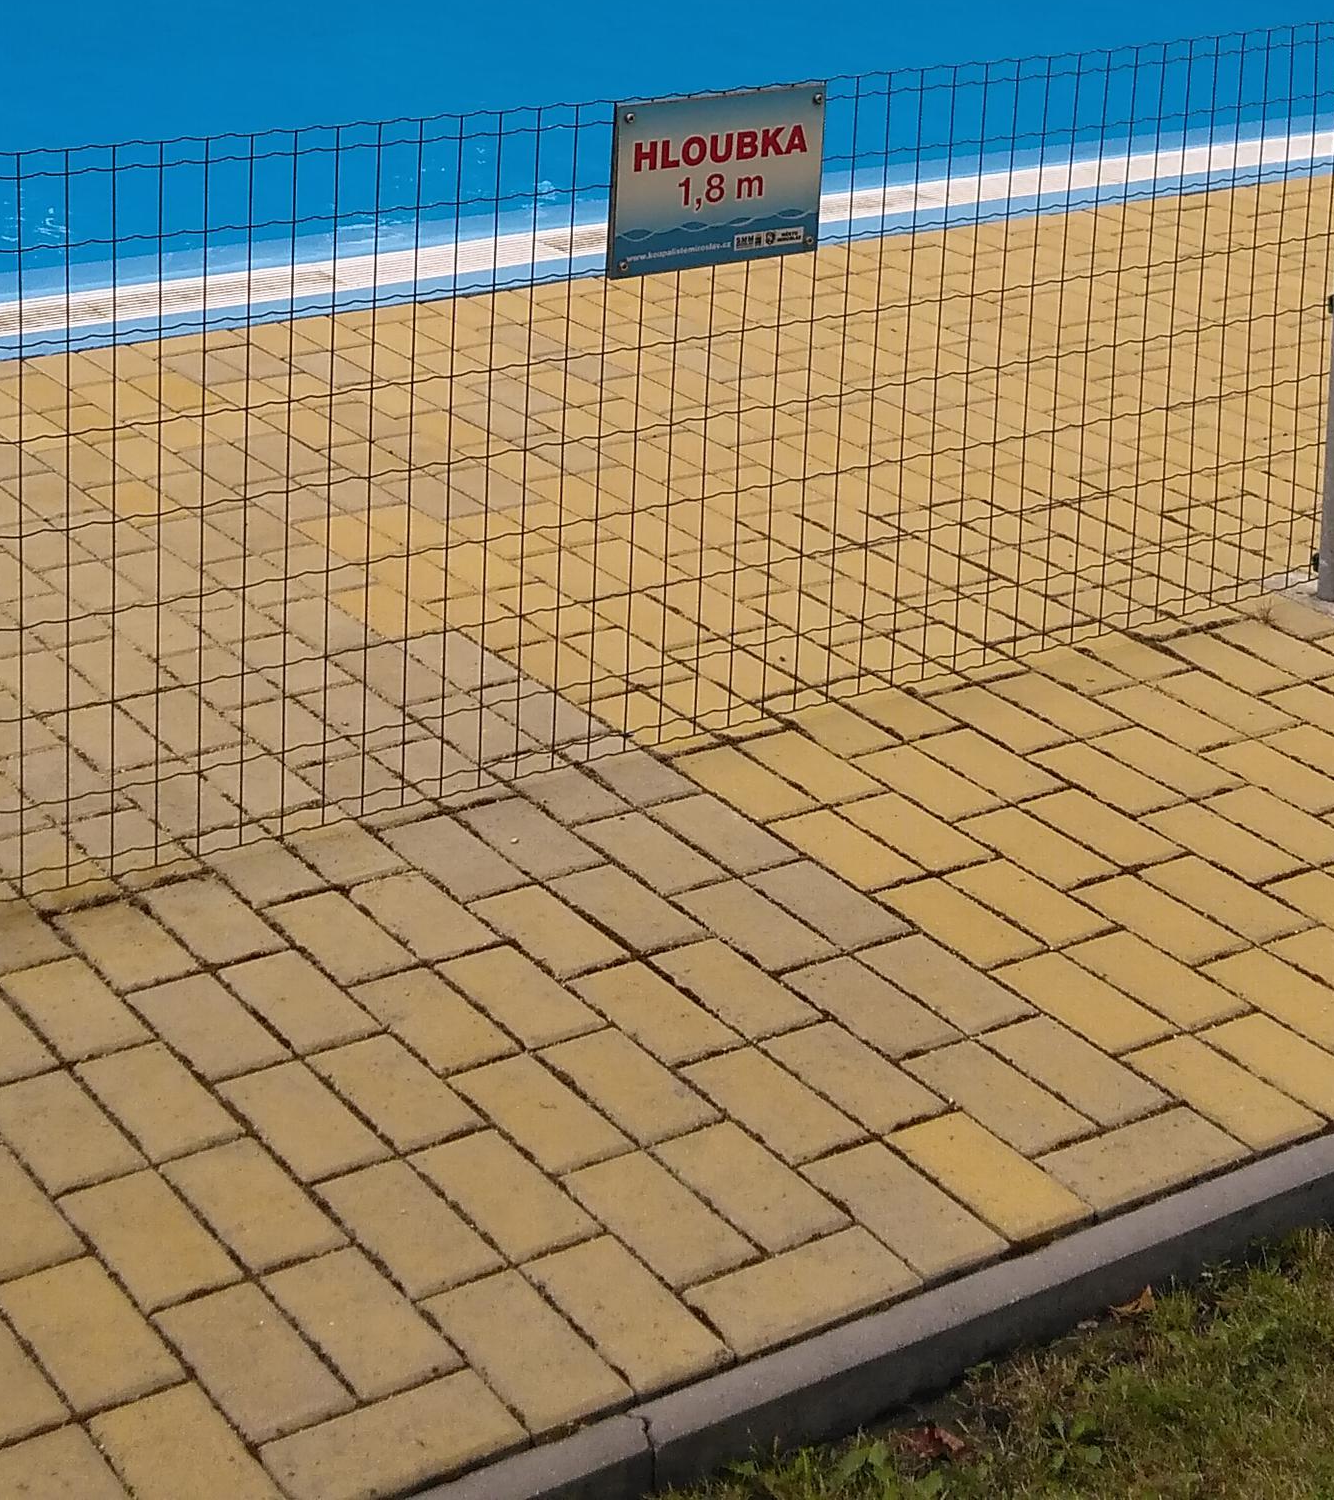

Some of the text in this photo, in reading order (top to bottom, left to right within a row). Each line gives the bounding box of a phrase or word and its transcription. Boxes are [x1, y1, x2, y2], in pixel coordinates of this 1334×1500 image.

[633, 124, 808, 173] HLOUBKA
[678, 173, 764, 212] 1,8 m
